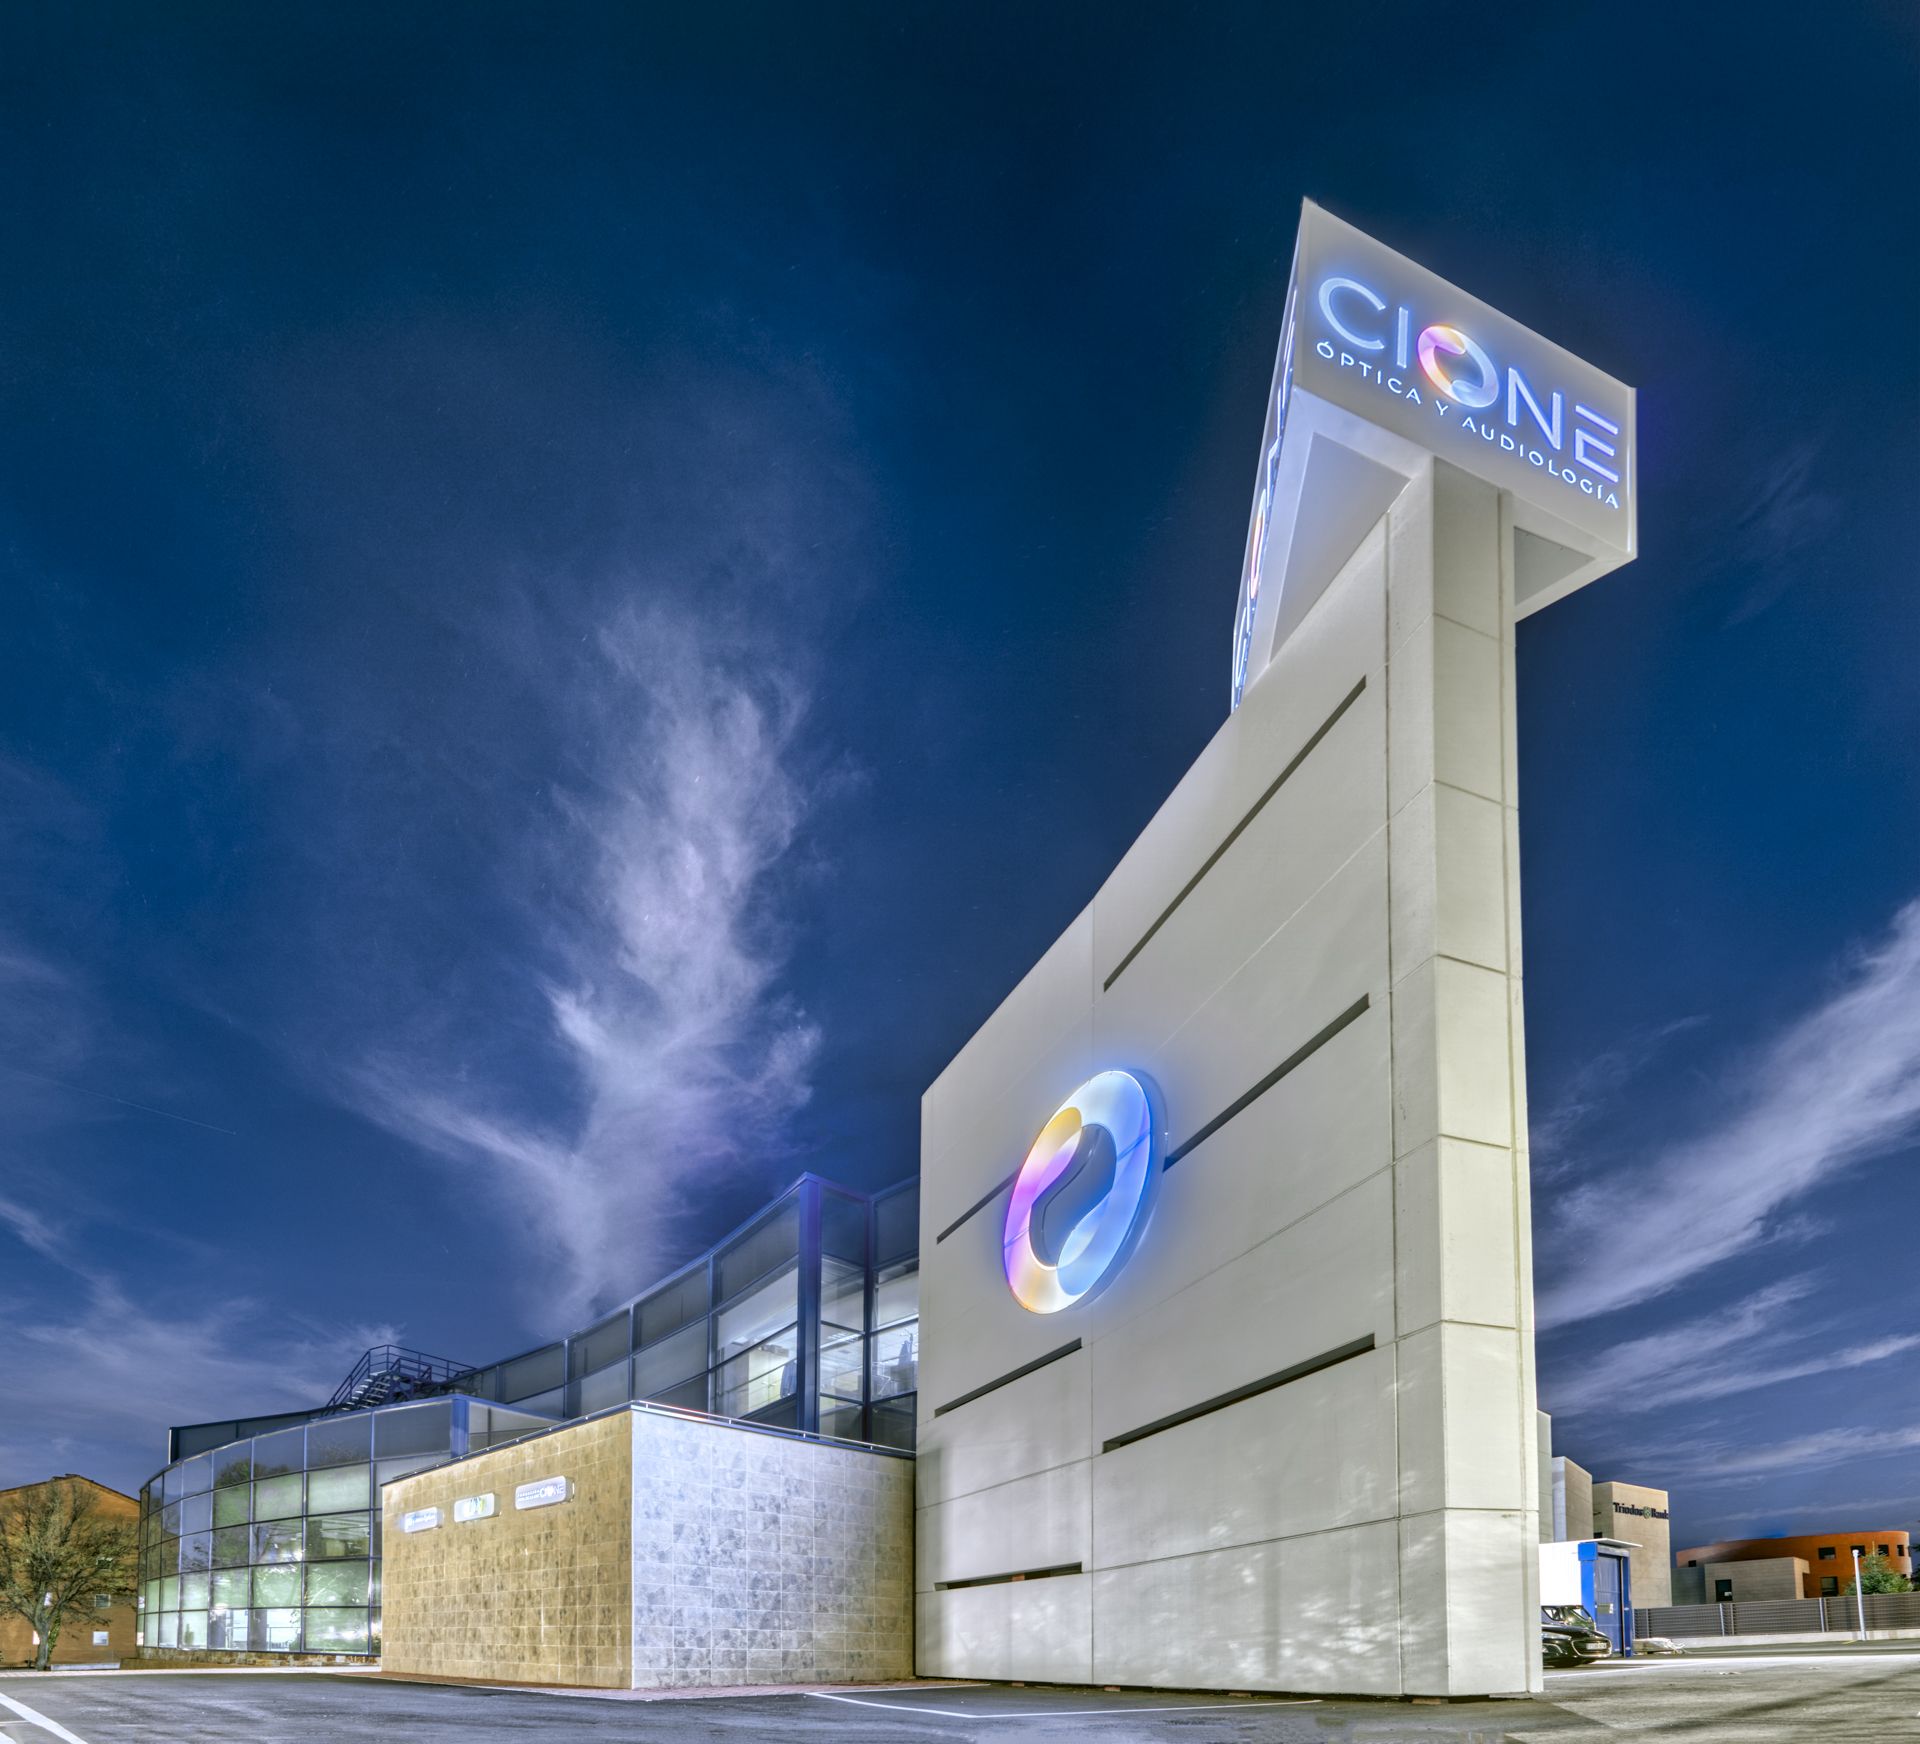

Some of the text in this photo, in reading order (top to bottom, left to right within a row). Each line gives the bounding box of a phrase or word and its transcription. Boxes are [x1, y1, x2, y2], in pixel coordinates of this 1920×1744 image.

[1316, 341, 1619, 509] ÓPTICA Y AUDIOLOGÍA
[1318, 277, 1619, 483] CIONE
[1612, 1502, 1644, 1517] Triodos
